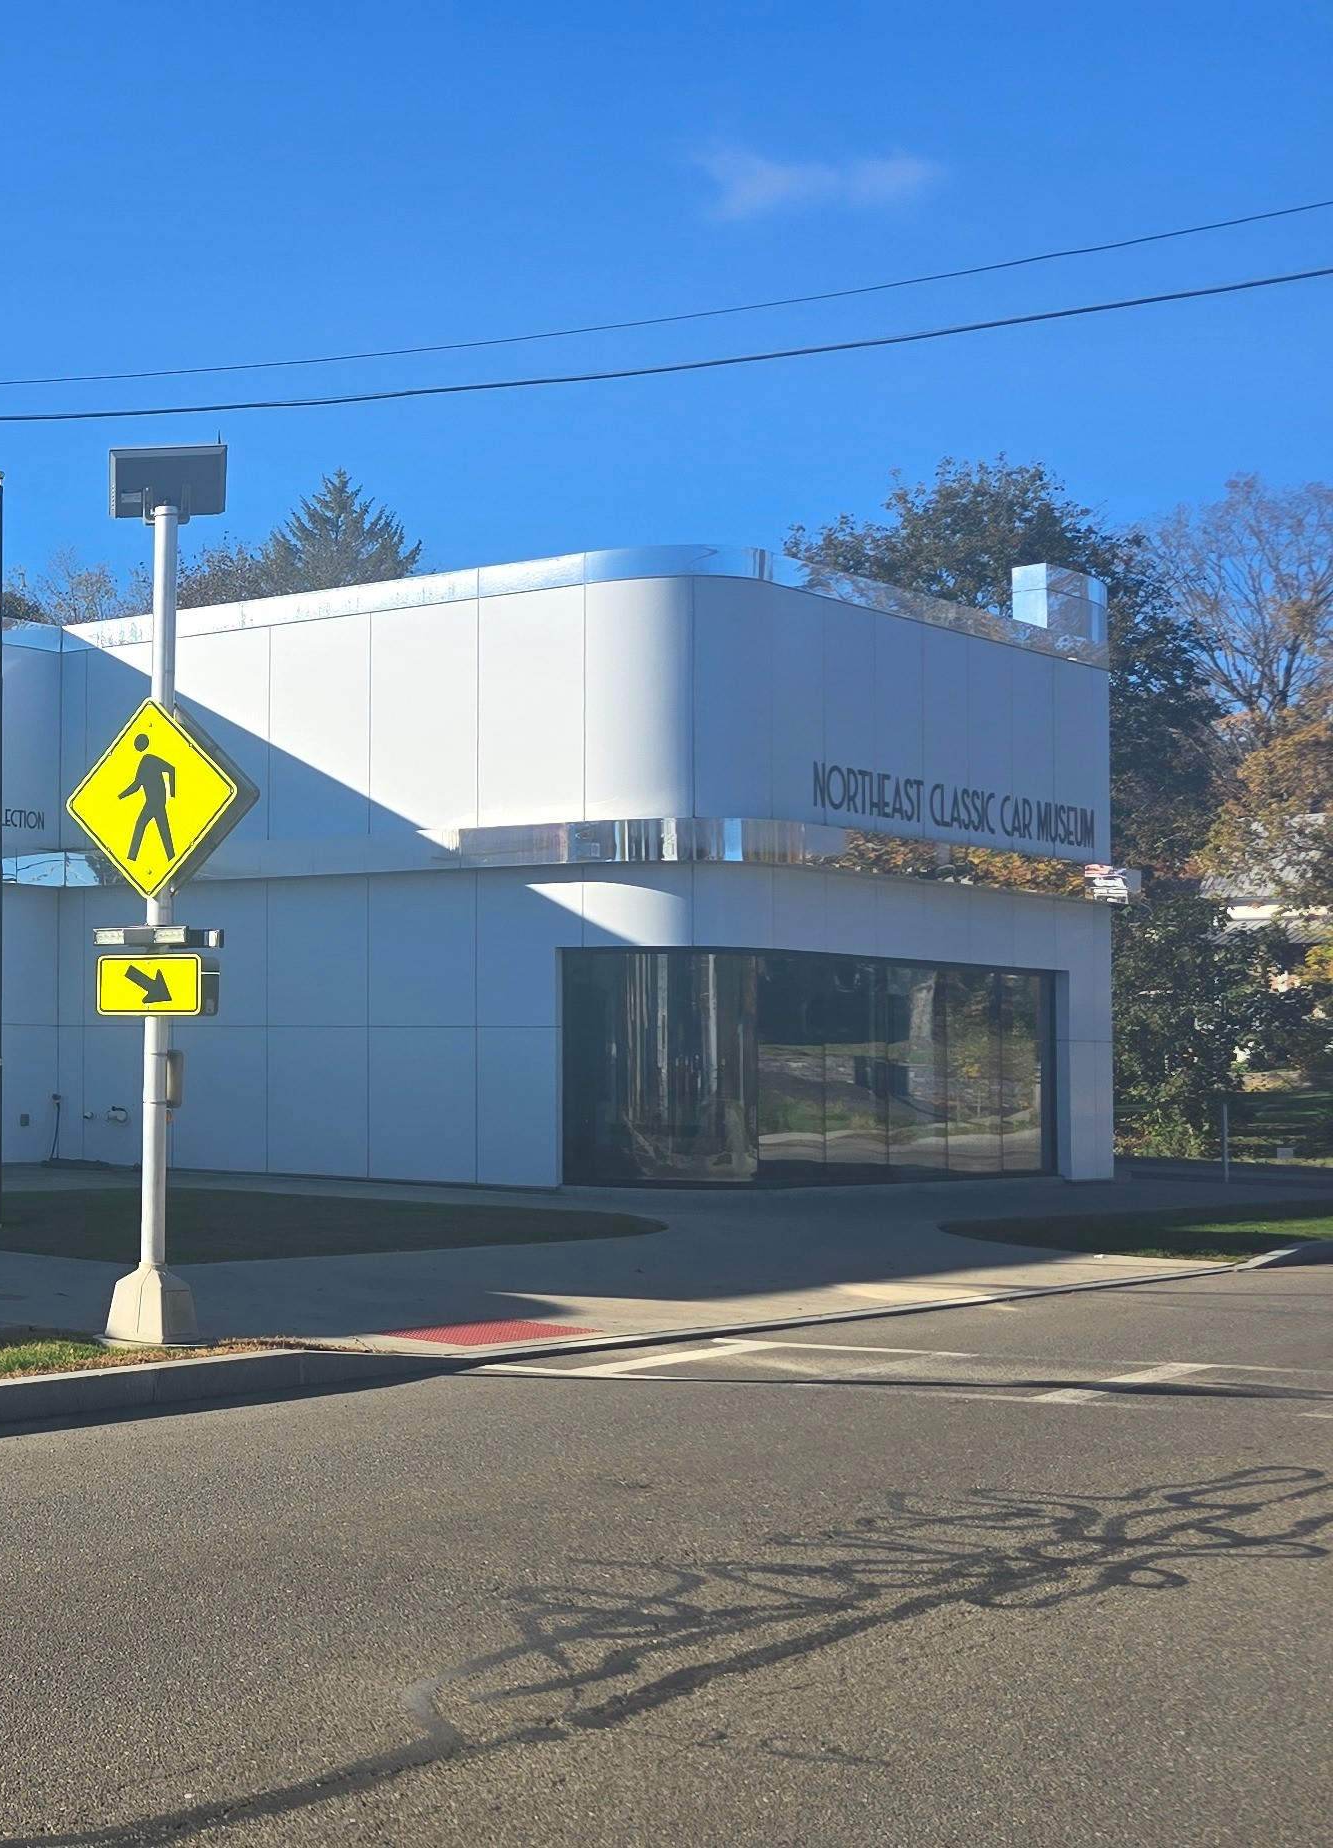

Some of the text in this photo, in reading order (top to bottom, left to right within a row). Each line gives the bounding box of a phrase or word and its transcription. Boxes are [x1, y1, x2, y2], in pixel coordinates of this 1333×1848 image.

[812, 760, 1096, 849] NORTHEAST CLASSIC CAR MUSEUM
